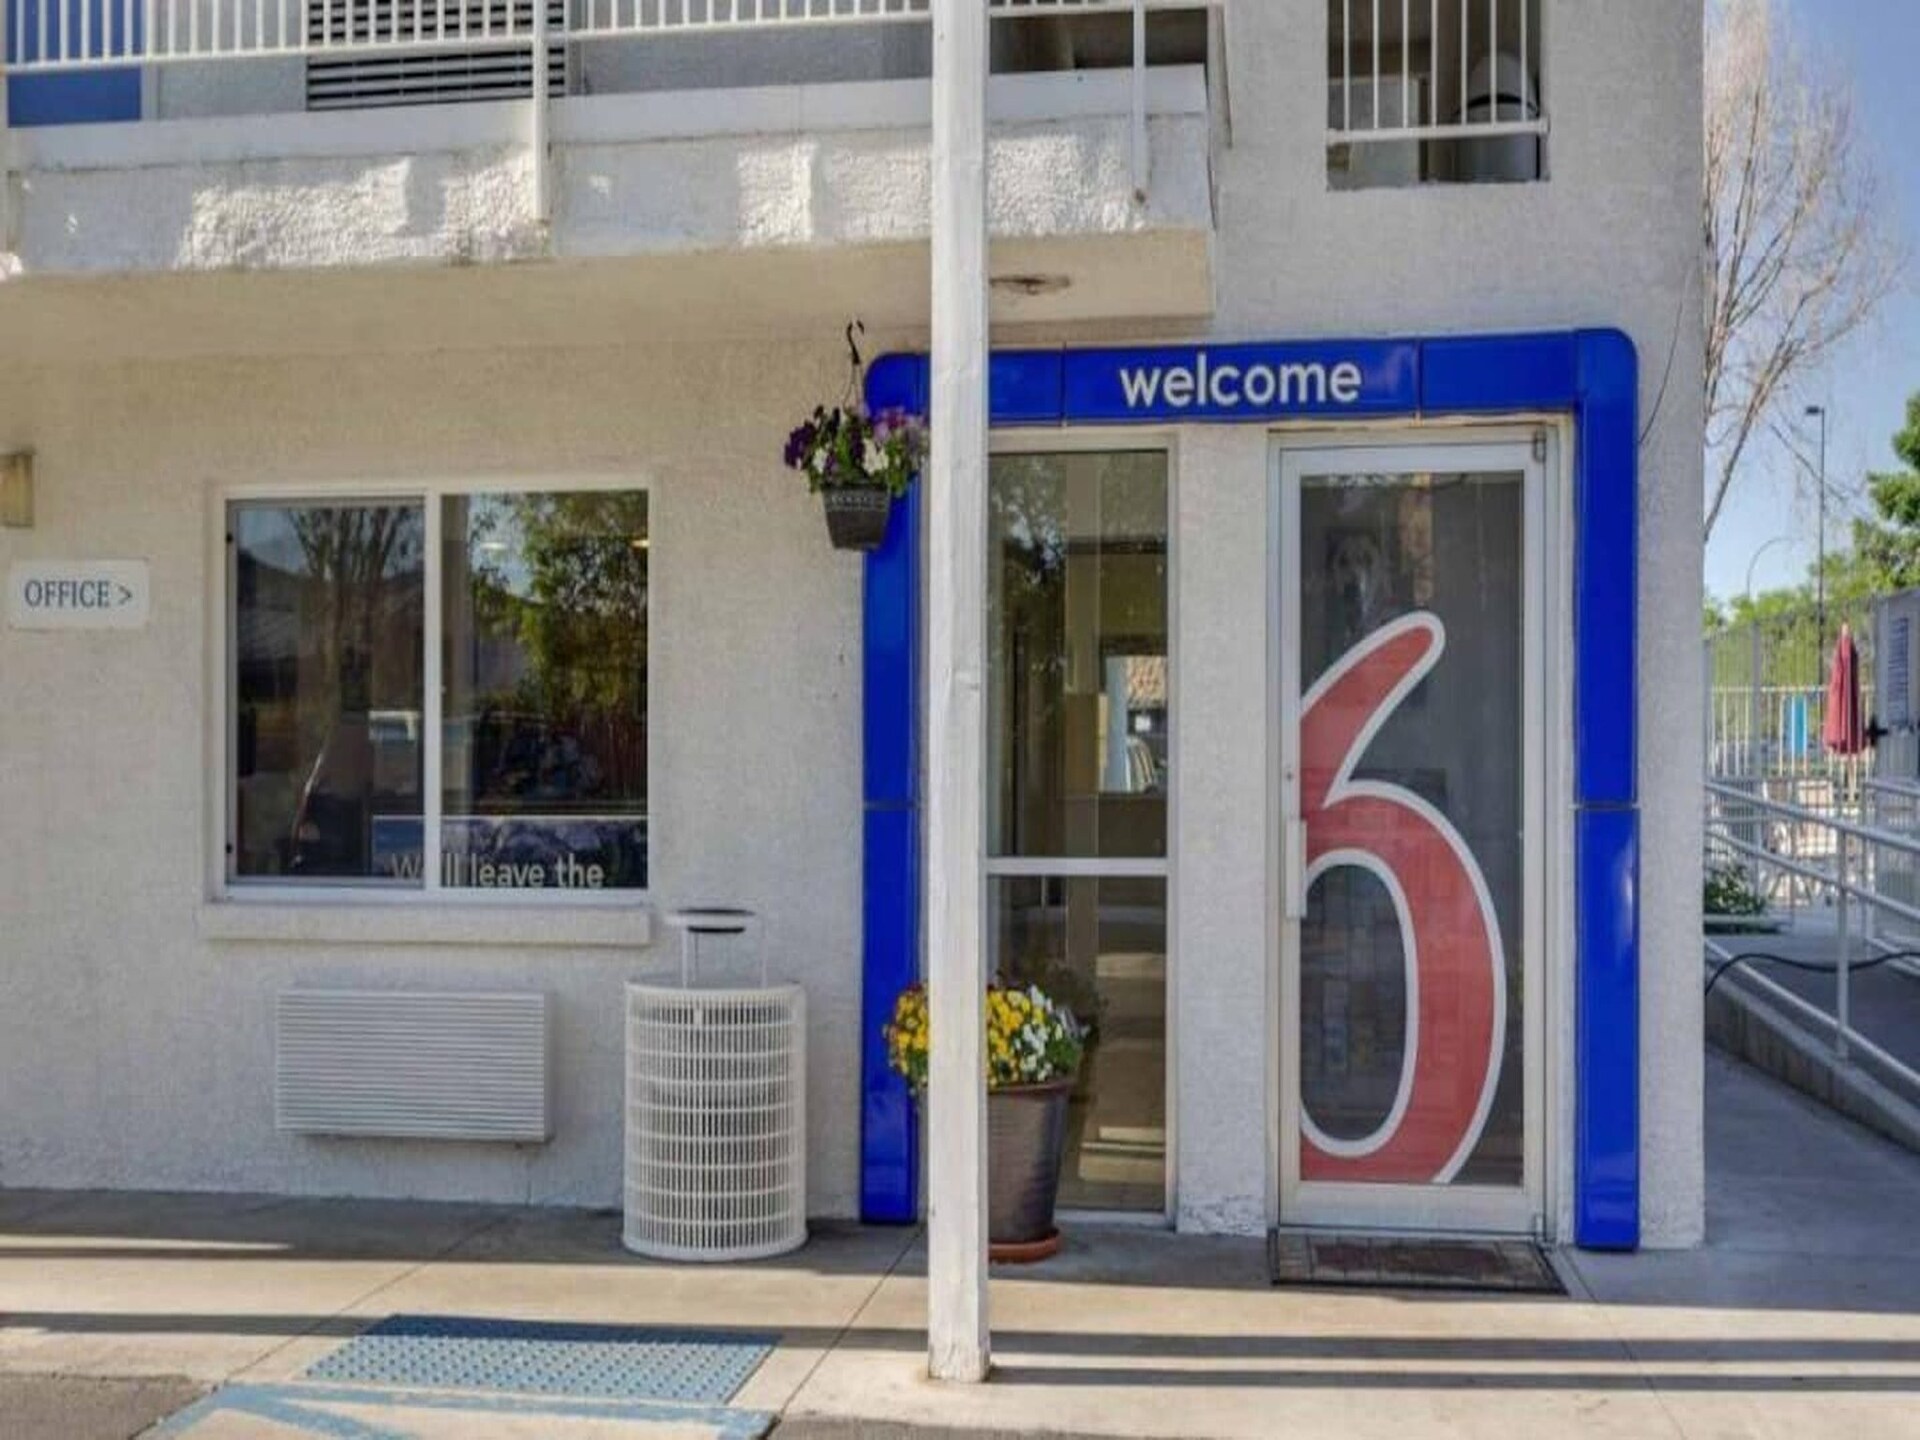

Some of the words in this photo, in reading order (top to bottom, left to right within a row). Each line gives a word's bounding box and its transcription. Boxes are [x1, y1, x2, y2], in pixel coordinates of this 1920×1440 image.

[1120, 352, 1362, 407] welcome
[24, 579, 110, 608] OFFICE
[472, 852, 545, 887] leave
[556, 852, 604, 887] the
